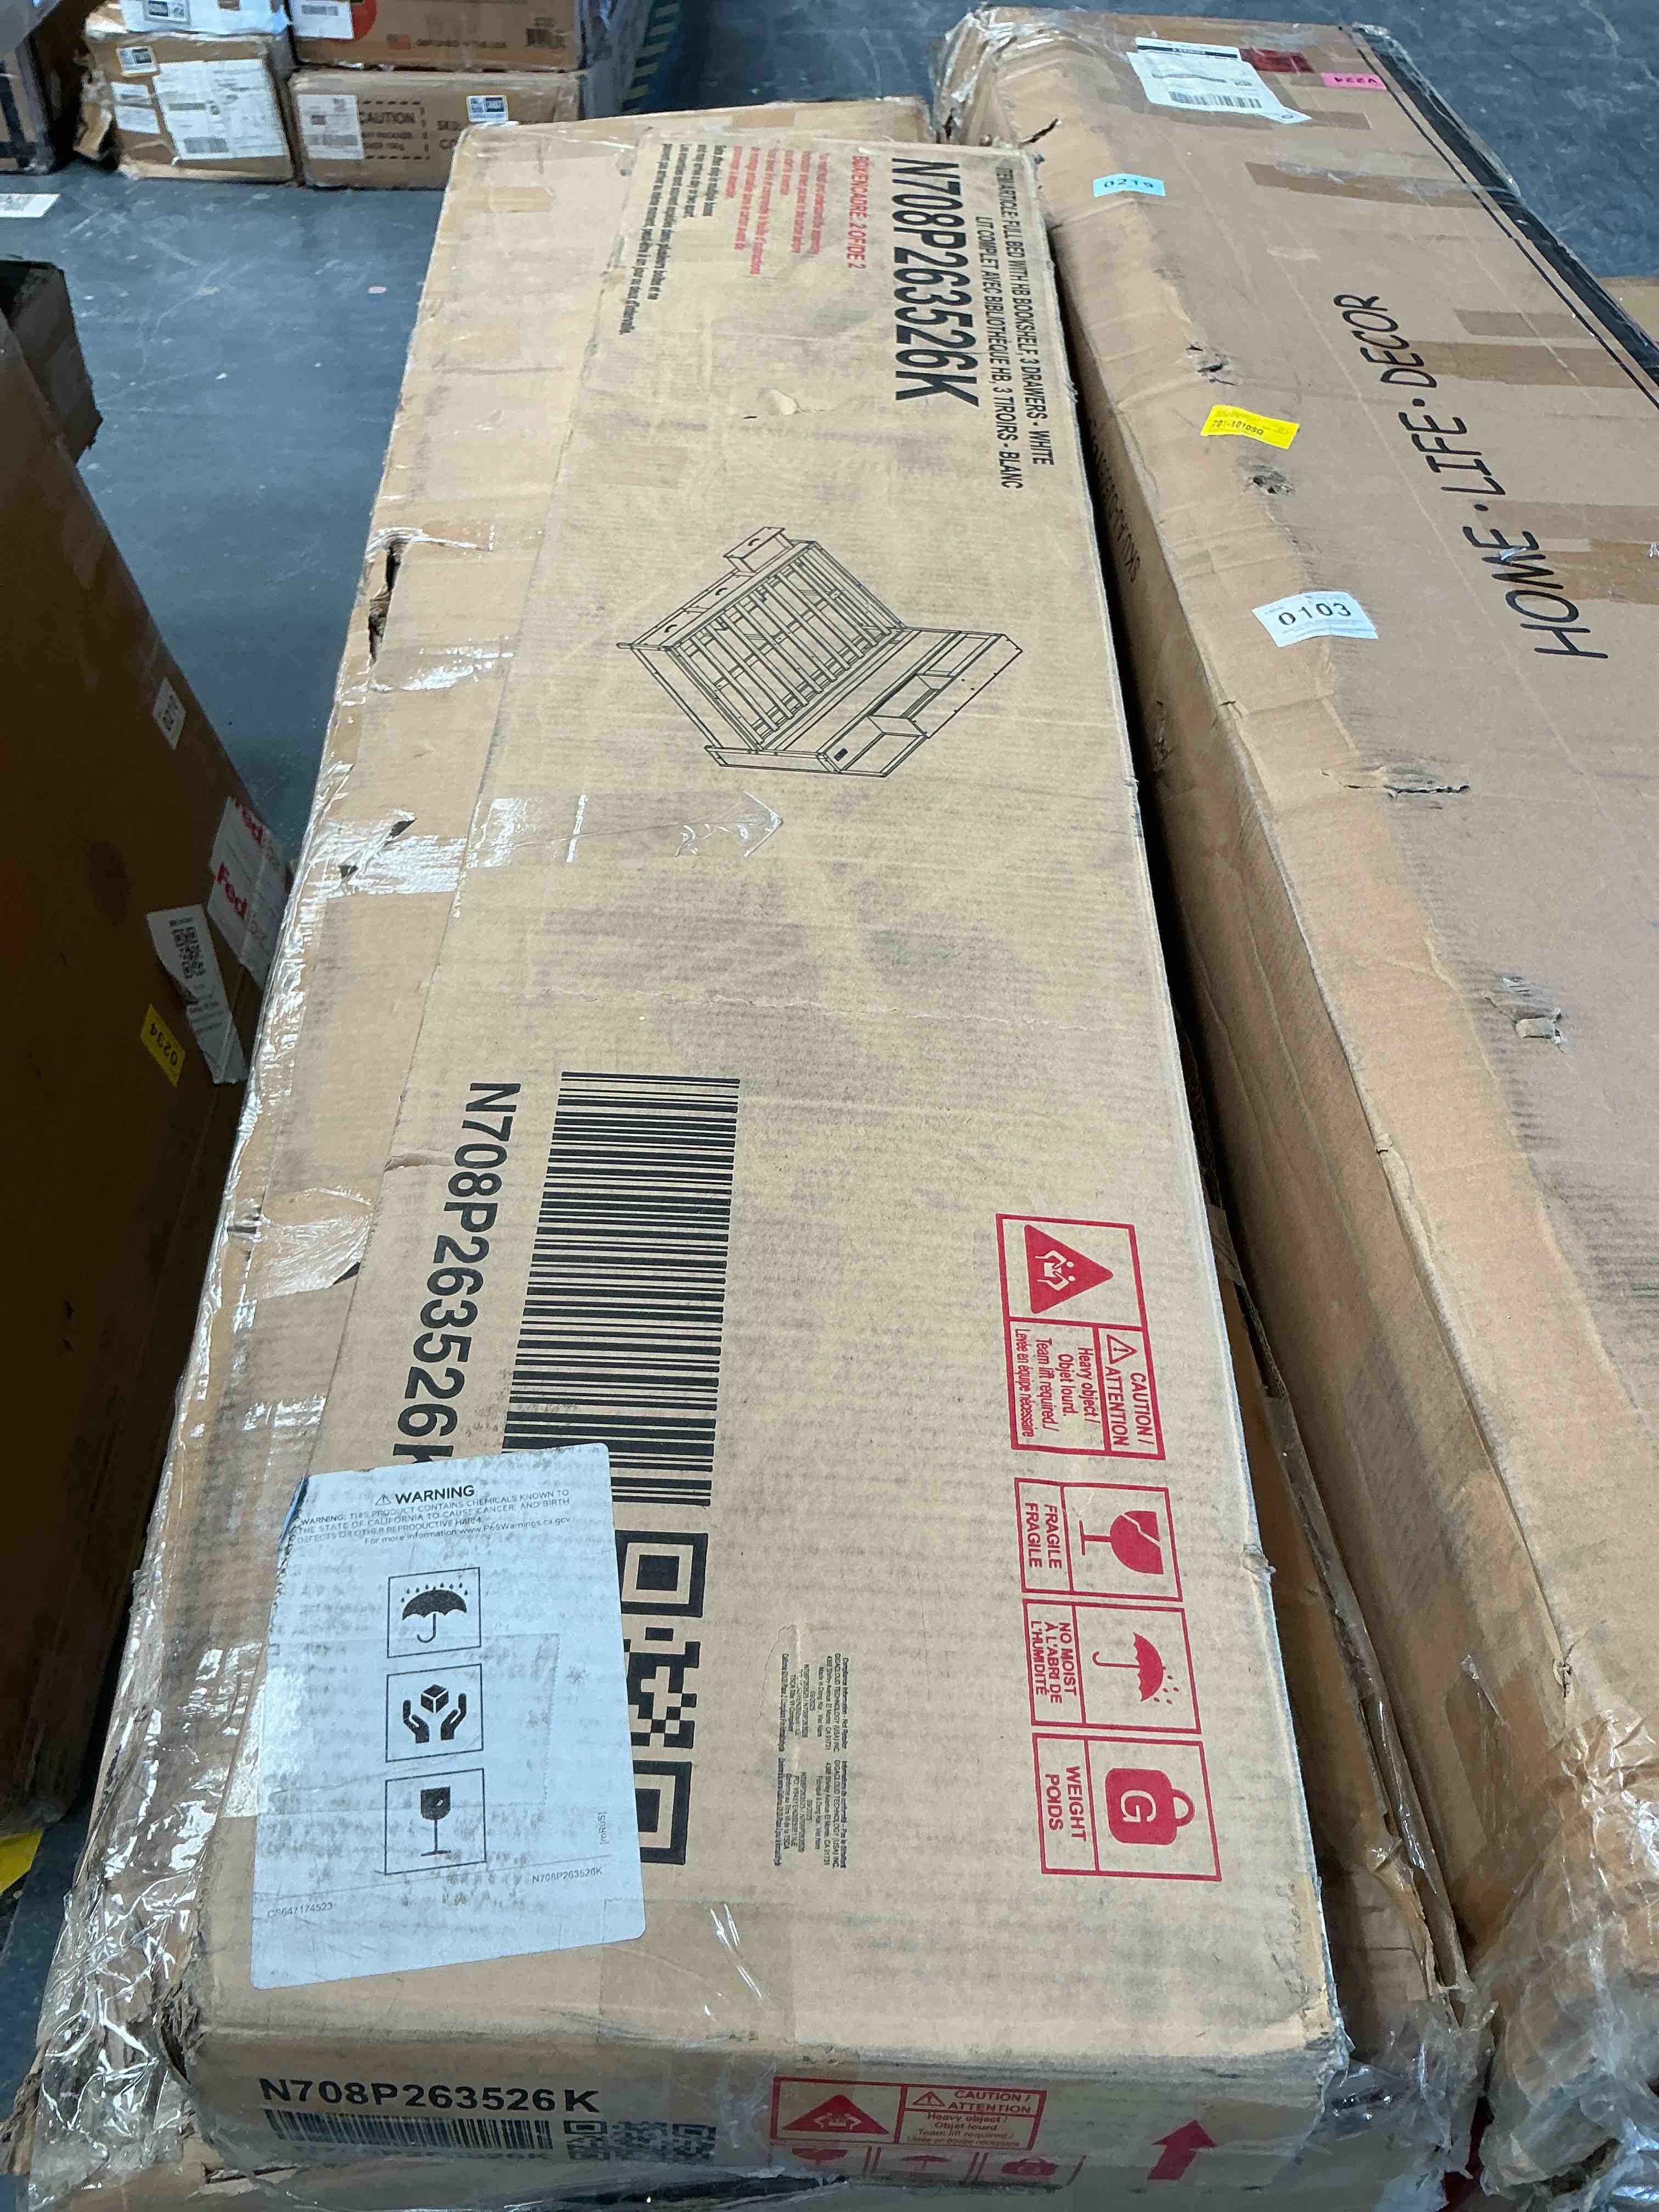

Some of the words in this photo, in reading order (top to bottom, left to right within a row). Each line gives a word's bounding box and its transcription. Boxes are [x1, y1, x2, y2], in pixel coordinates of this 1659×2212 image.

[975, 216, 993, 229] LIT
[1002, 220, 1022, 239] FULL
[978, 230, 998, 269] COMPLET
[1005, 241, 1025, 257] BED
[891, 157, 980, 408] N708P263526K
[981, 271, 1001, 294] AVEC
[1008, 261, 1028, 281] WITH
[1011, 283, 1030, 296] HB
[1012, 297, 1039, 356] BOOKSHELF,
[1334, 294, 1438, 389] DECOR
[988, 368, 1012, 384] HB,
[1021, 366, 1048, 419] DRAWERS
[993, 396, 1018, 441] TIROIRS
[1029, 431, 1054, 465] WHITE
[1398, 411, 1506, 495] LIFE
[998, 452, 1023, 489] BLANC
[1463, 525, 1610, 659] HOME
[1278, 601, 1352, 625] 0103
[1017, 1354, 1030, 1364] en
[1035, 1338, 1052, 1364] Team
[1077, 1347, 1093, 1384] Heavy
[1039, 1367, 1054, 1379] lift
[1056, 1354, 1074, 1383] Objet
[1078, 1383, 1098, 1416] object
[1105, 1367, 1129, 1446] ATTENTION
[1130, 1372, 1154, 1436] CAUTION
[301, 1514, 347, 1526] WARNING:
[371, 1506, 414, 1517] PRODUCT
[418, 1500, 464, 1512] CONTAINS
[466, 1497, 517, 1508] CHEMICALS
[520, 1491, 554, 1500] KNOWN
[395, 1485, 475, 1504] WARNING
[319, 1522, 348, 1531] STATE
[367, 1514, 424, 1526] CALIFORNIA
[443, 1508, 473, 1518] CAUSE
[543, 1498, 570, 1506] BIRTH
[354, 1527, 384, 1537] OTHER
[386, 1520, 453, 1533] REPRODUCTIVE
[1025, 1502, 1042, 1568] FRAGILE
[1044, 1503, 1063, 1569] FRAGILE
[1059, 1622, 1071, 1643] NO
[1061, 1646, 1077, 1695] MOIST
[1049, 1686, 1063, 1703] DE
[1045, 1773, 1064, 1830] POIDS
[1065, 1765, 1087, 1842] WEIGHT
[259, 2078, 600, 2113] N708P263526K
[947, 2102, 1031, 2113] ATTENTION
[954, 2091, 1022, 2102] CAUTION
[927, 2112, 962, 2121] Heavy
[966, 2115, 1001, 2123] object
